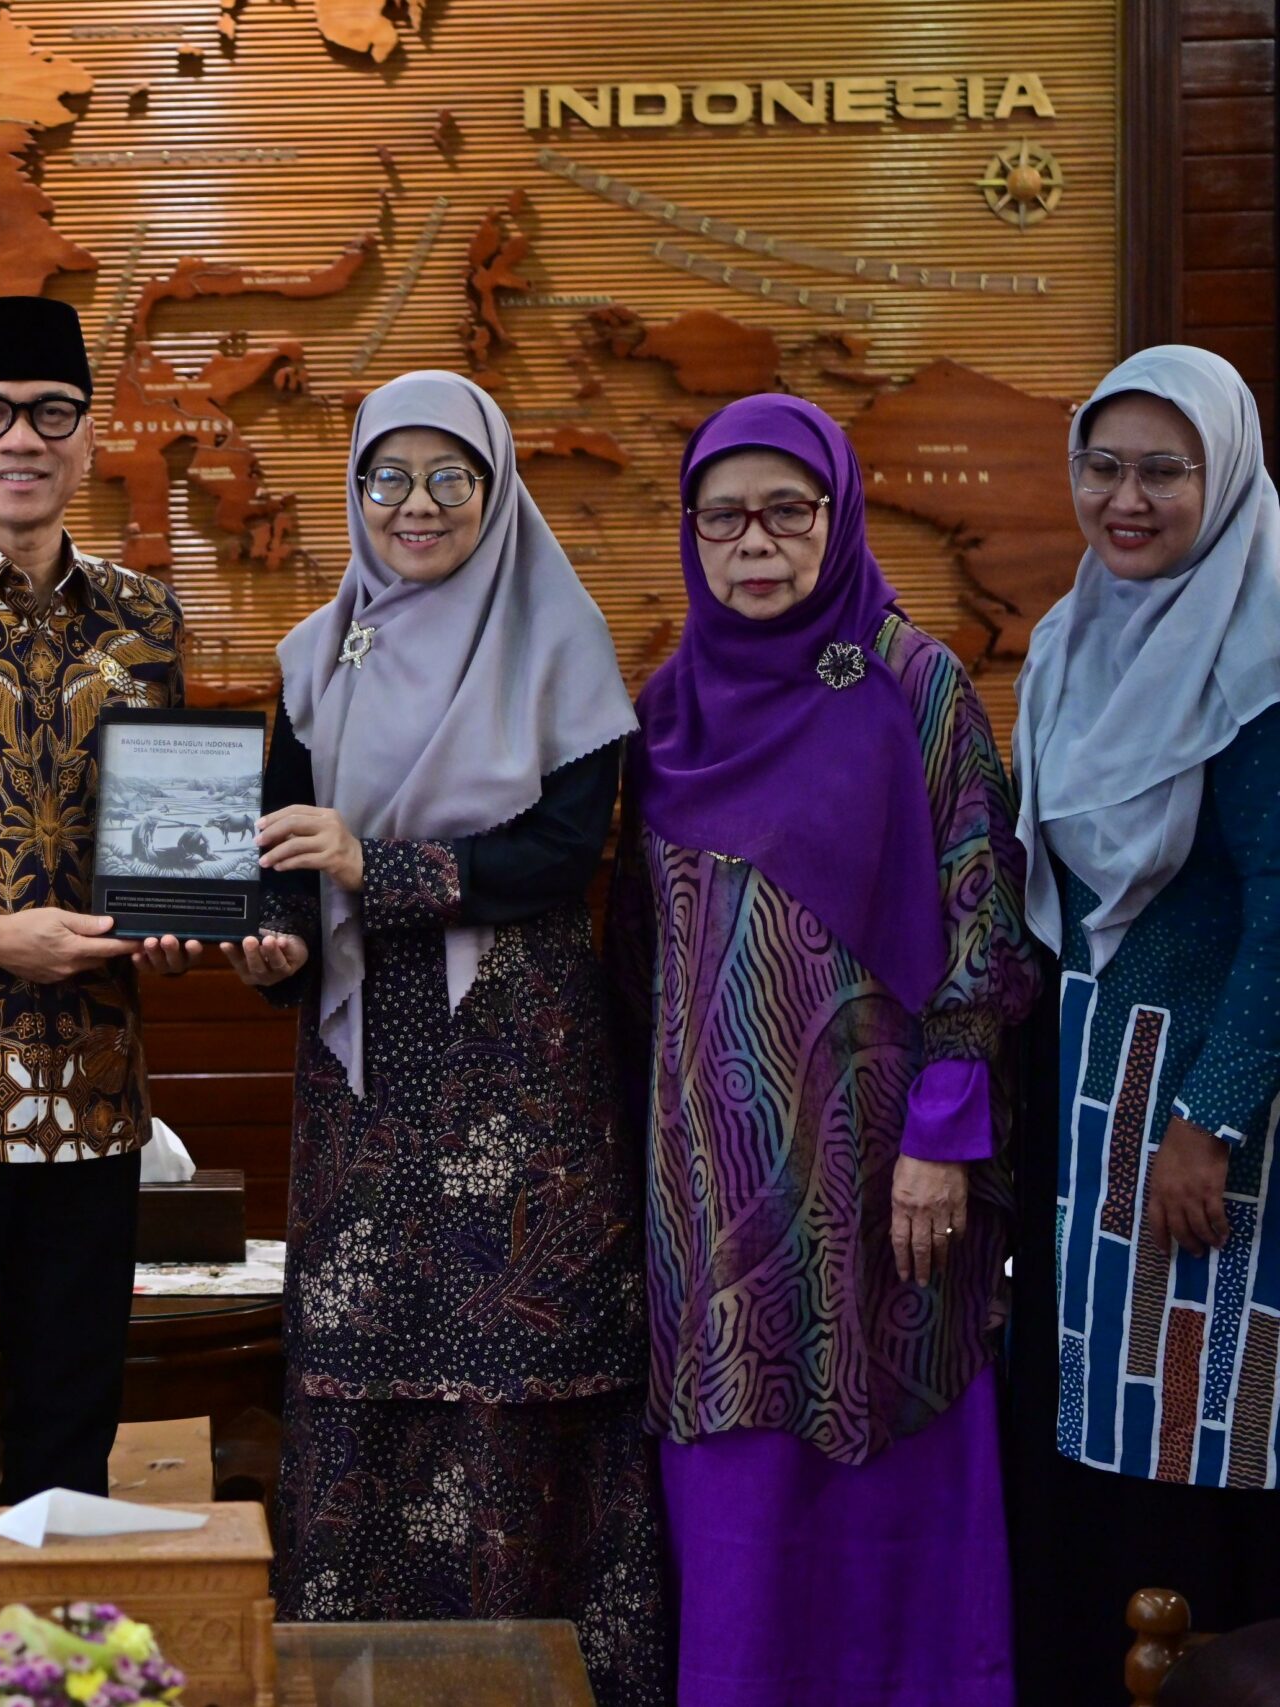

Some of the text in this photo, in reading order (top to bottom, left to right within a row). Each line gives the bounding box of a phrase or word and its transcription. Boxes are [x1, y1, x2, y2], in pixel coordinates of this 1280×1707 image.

[523, 73, 1056, 129] INDONESIA
[856, 257, 1047, 294] PASIFIK
[133, 419, 234, 433] SULAWESI
[906, 470, 989, 484] IRIAN
[121, 738, 151, 746] BANGUN
[173, 740, 203, 748] BANGUN
[206, 741, 243, 749] INDONESIA
